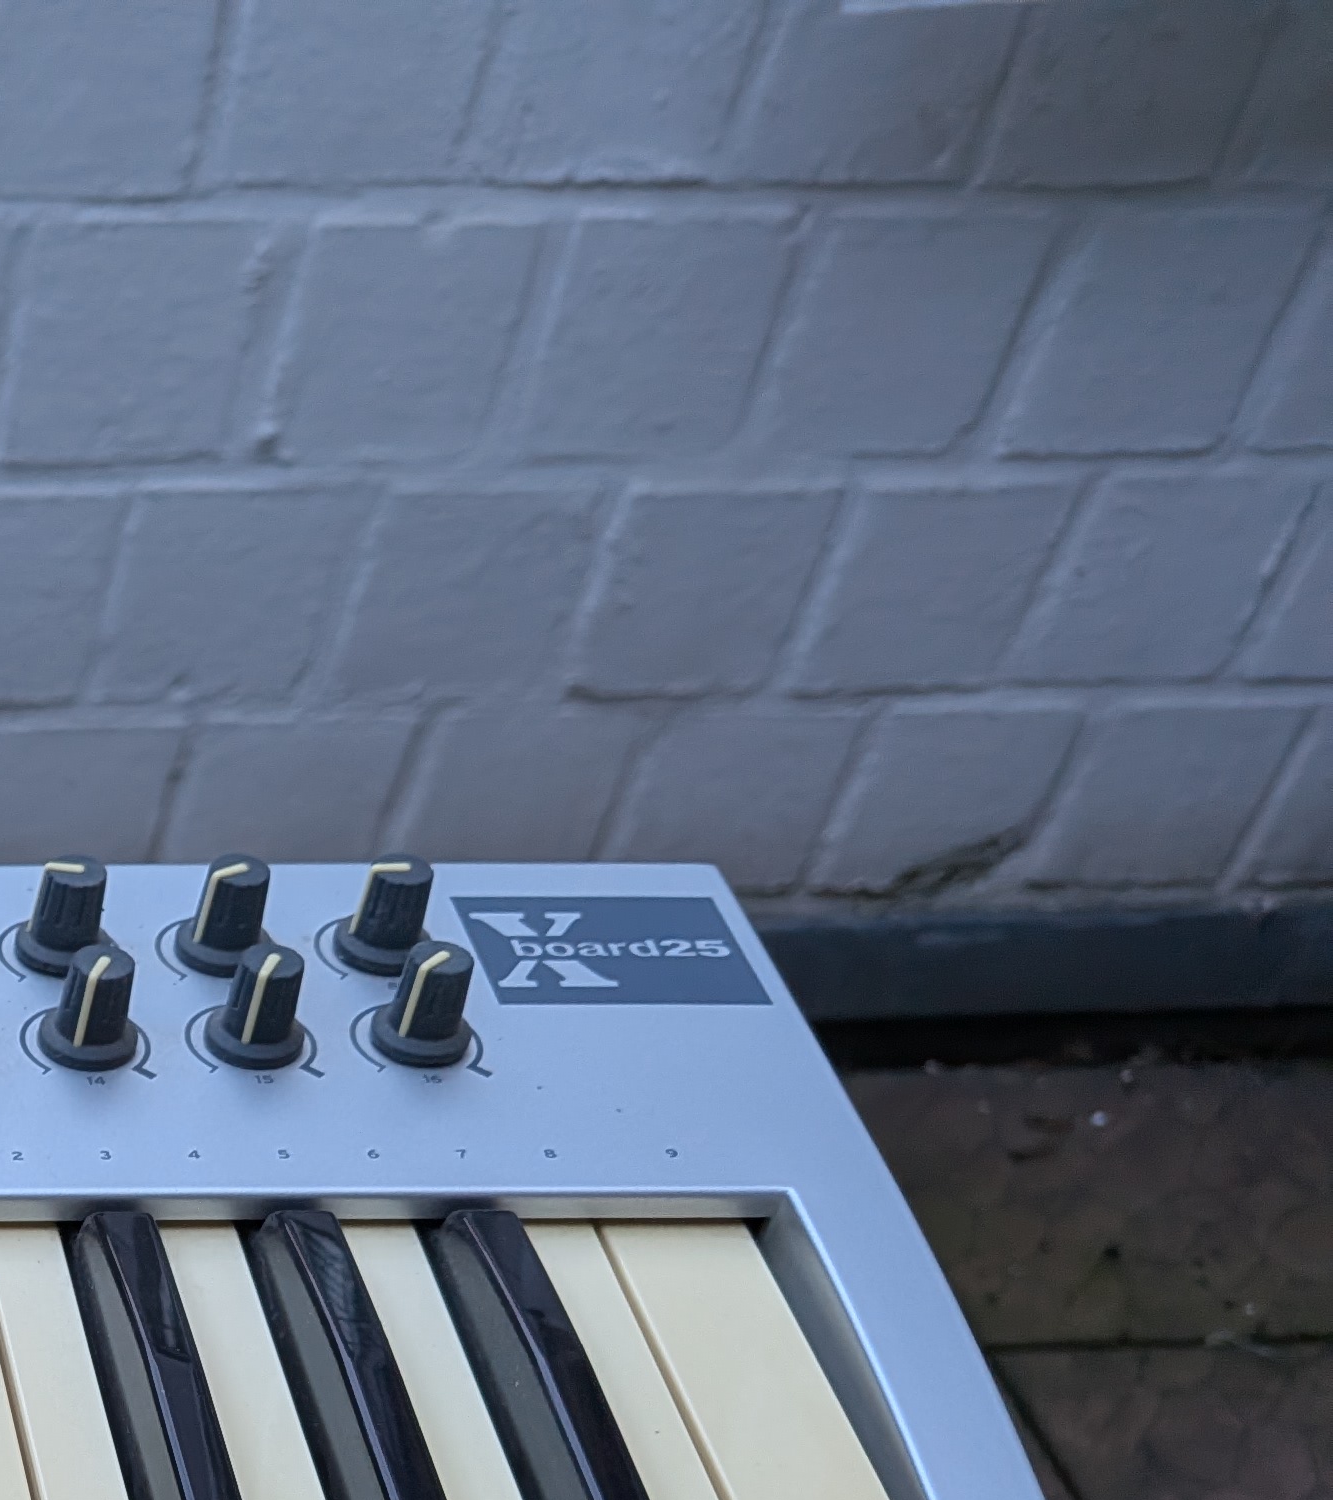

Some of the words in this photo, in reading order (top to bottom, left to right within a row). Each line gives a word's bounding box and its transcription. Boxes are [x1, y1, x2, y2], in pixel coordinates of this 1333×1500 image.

[510, 938, 731, 959] board25
[86, 1075, 107, 1087] 14
[254, 1073, 275, 1086] 15
[12, 1151, 23, 1162] 2
[100, 1150, 112, 1161] 3
[187, 1150, 201, 1161] 4
[277, 1149, 290, 1161] 5
[366, 1149, 380, 1160] 6
[454, 1149, 466, 1160] 7
[544, 1148, 558, 1160] 8
